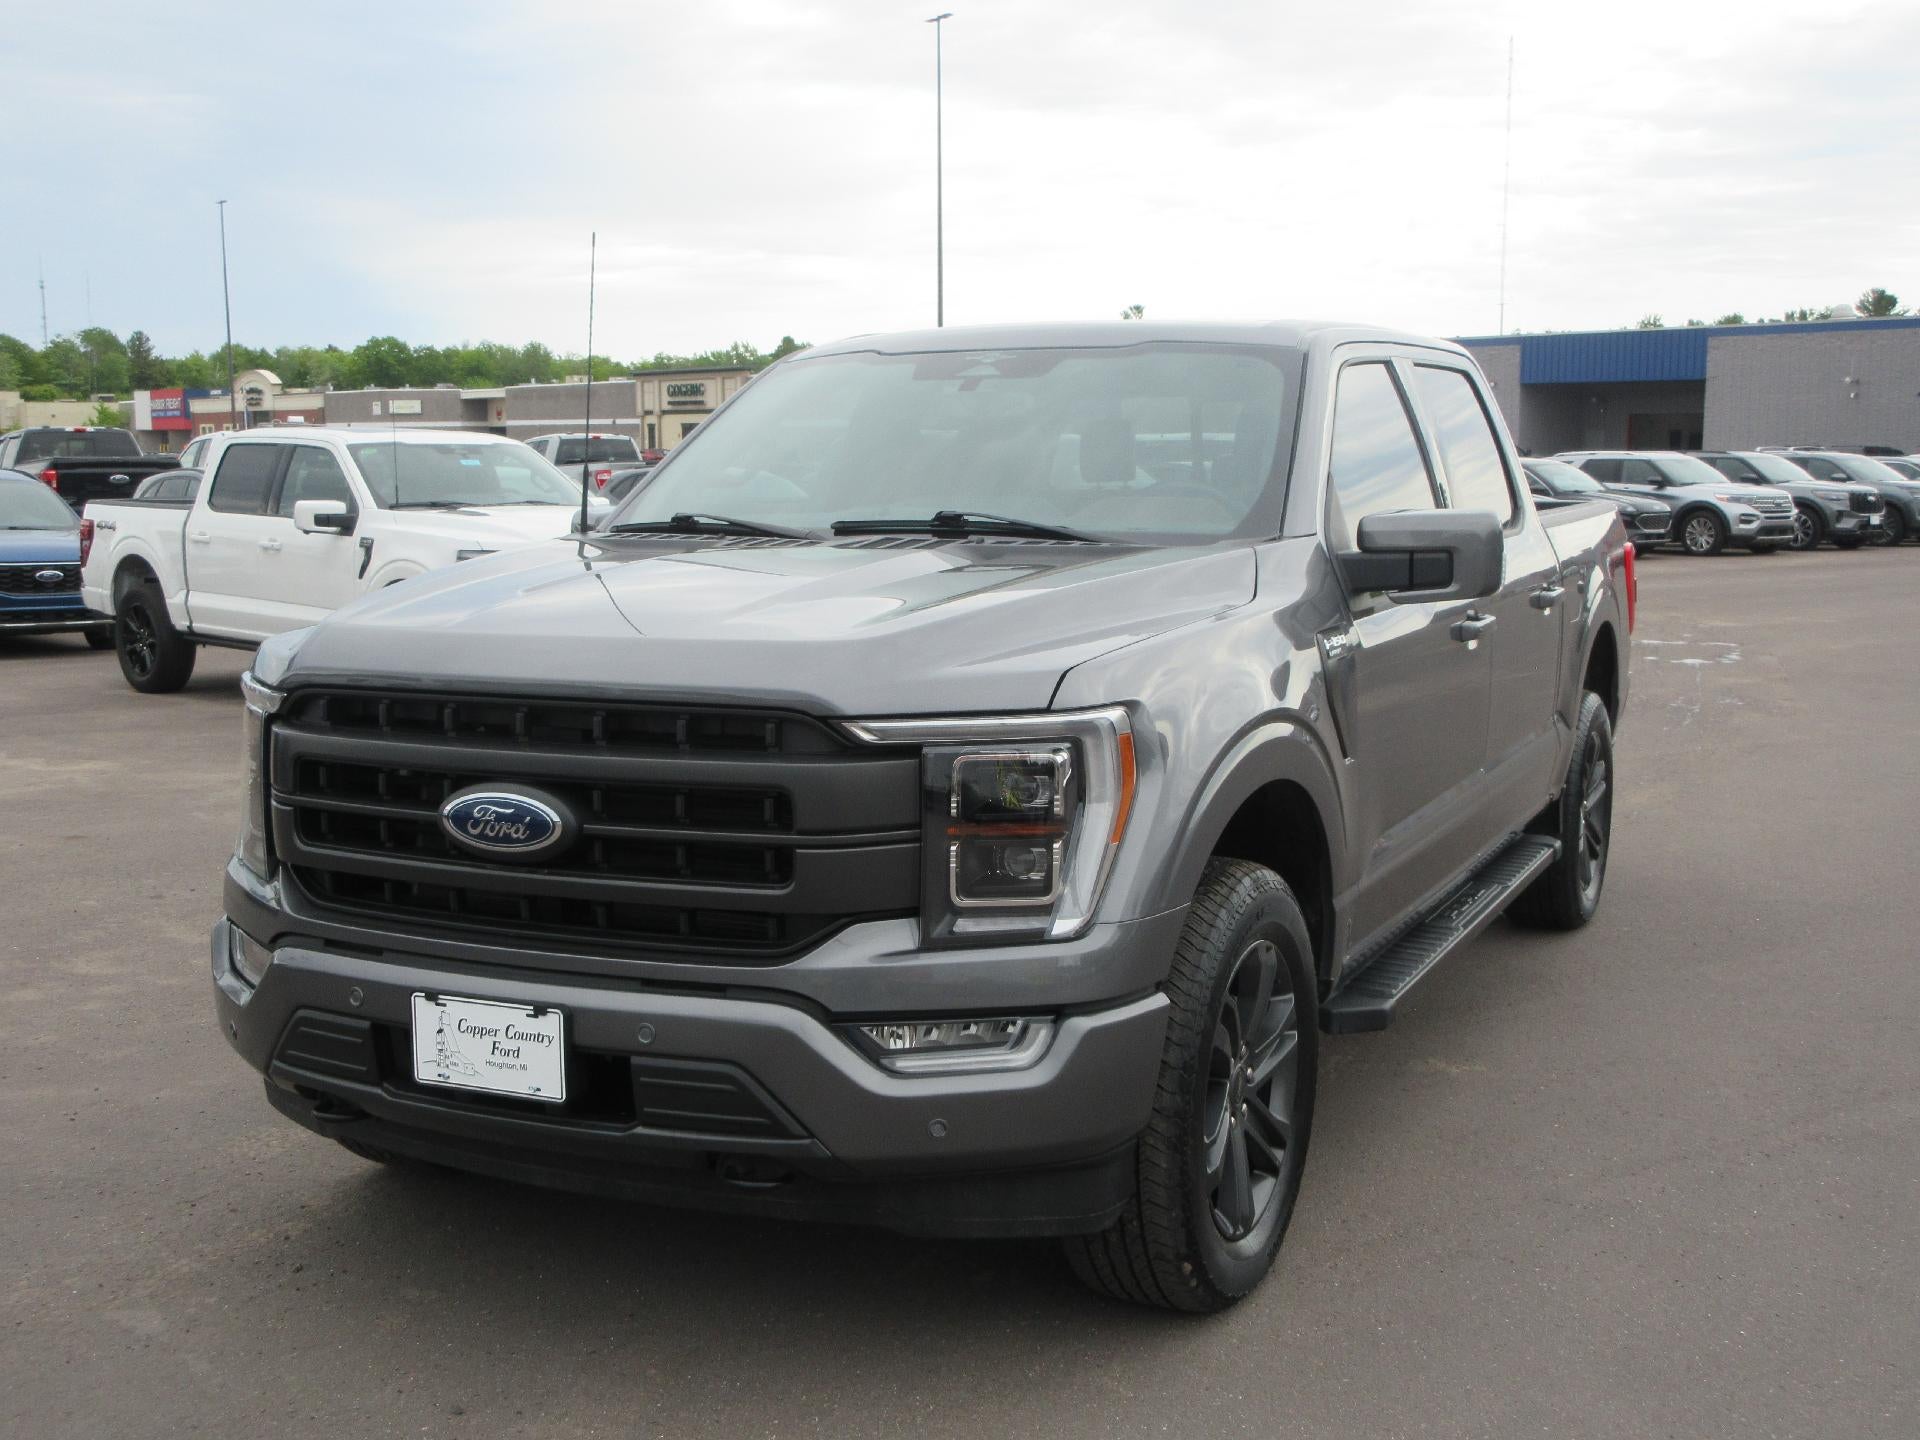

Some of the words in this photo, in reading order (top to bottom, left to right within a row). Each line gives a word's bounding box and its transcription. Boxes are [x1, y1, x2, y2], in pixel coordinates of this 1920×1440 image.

[467, 804, 531, 839] Ford
[457, 1018, 501, 1039] Copper
[505, 1023, 555, 1048] Country
[491, 1040, 521, 1060] Ford
[485, 1058, 519, 1071] Houghton,
